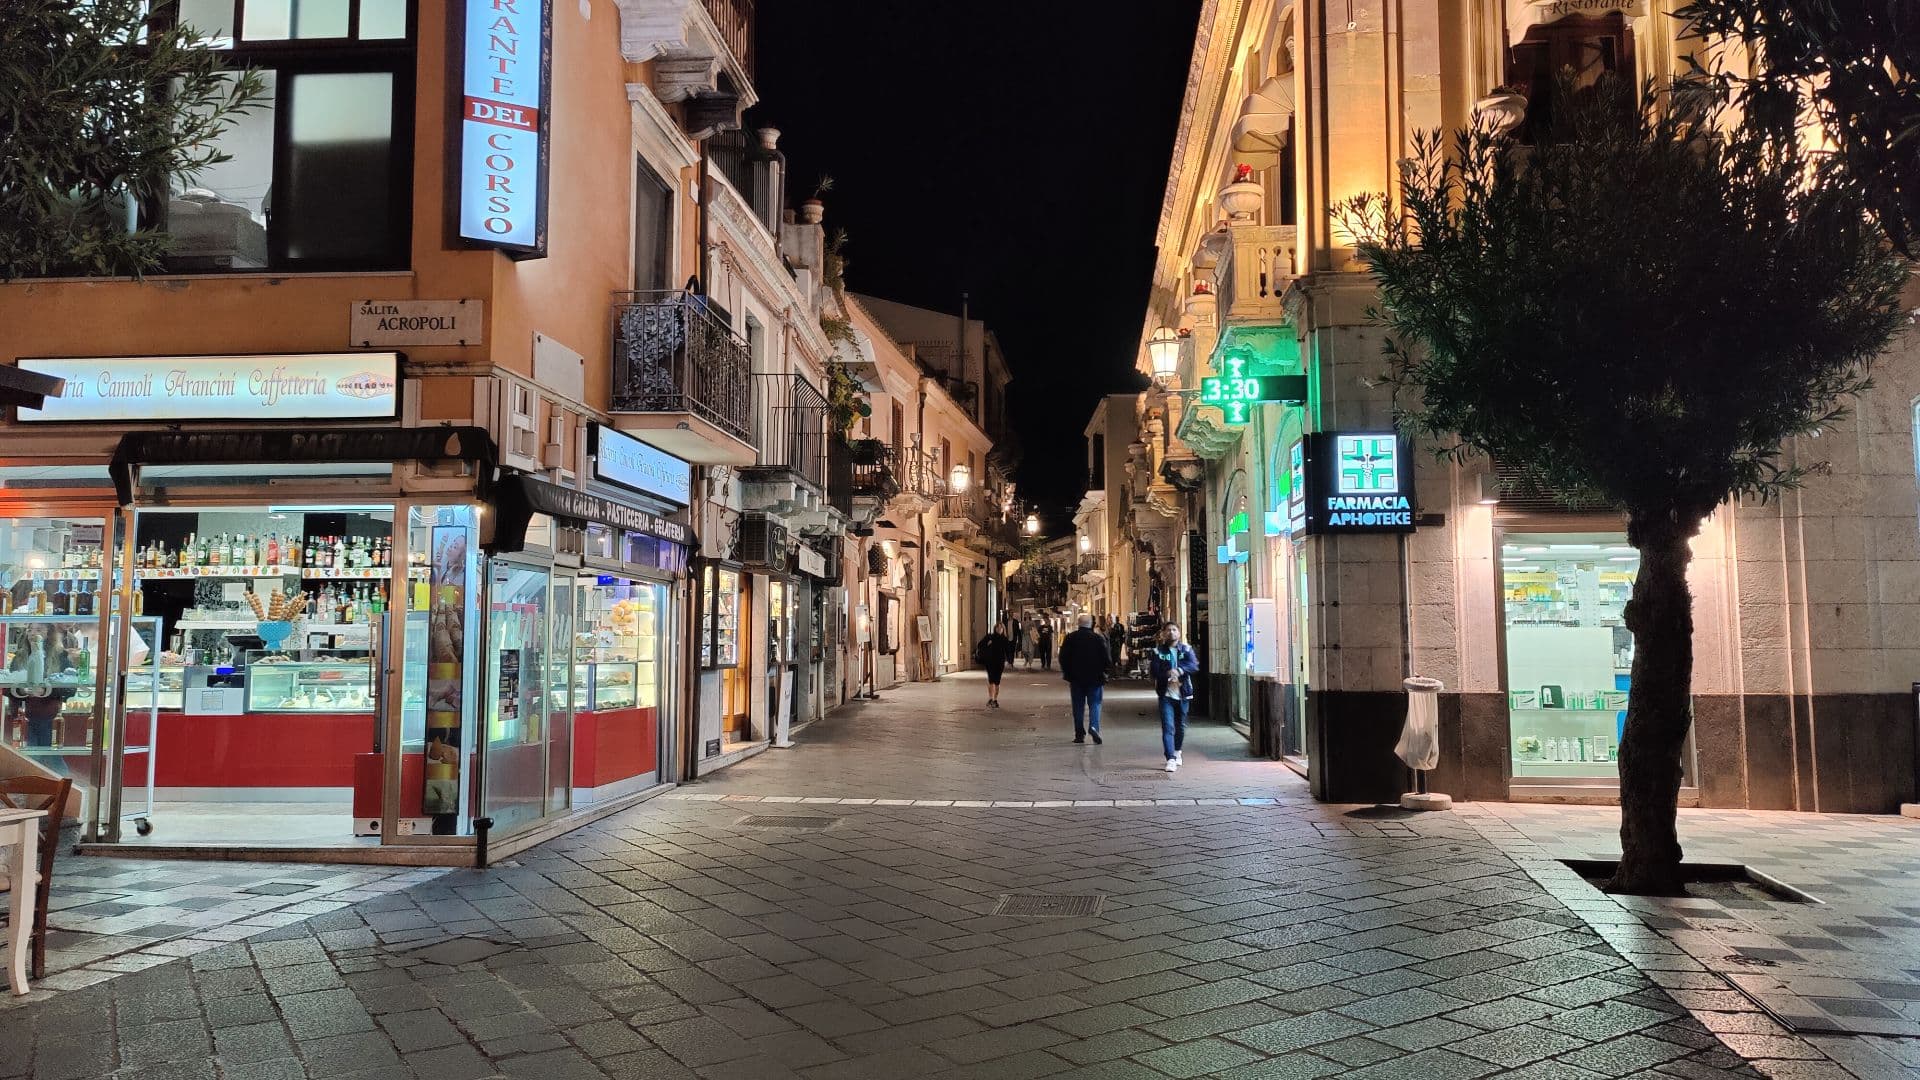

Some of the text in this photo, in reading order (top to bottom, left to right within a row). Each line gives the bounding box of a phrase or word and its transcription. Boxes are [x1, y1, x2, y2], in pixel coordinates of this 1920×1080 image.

[472, 102, 530, 127] DEL
[484, 133, 515, 235] CORSO
[360, 305, 399, 315] SALITA
[377, 316, 456, 331] ACROPOLI
[96, 370, 153, 398] Cannoli
[164, 369, 237, 398] Arancini
[248, 366, 327, 407] Caffetteria
[1327, 496, 1410, 510] FARMACIA
[573, 493, 600, 519] CALDA
[606, 501, 650, 531] PASTICCERIA
[654, 518, 685, 542] GELATERIA
[1328, 511, 1411, 526] APHOTEKE
